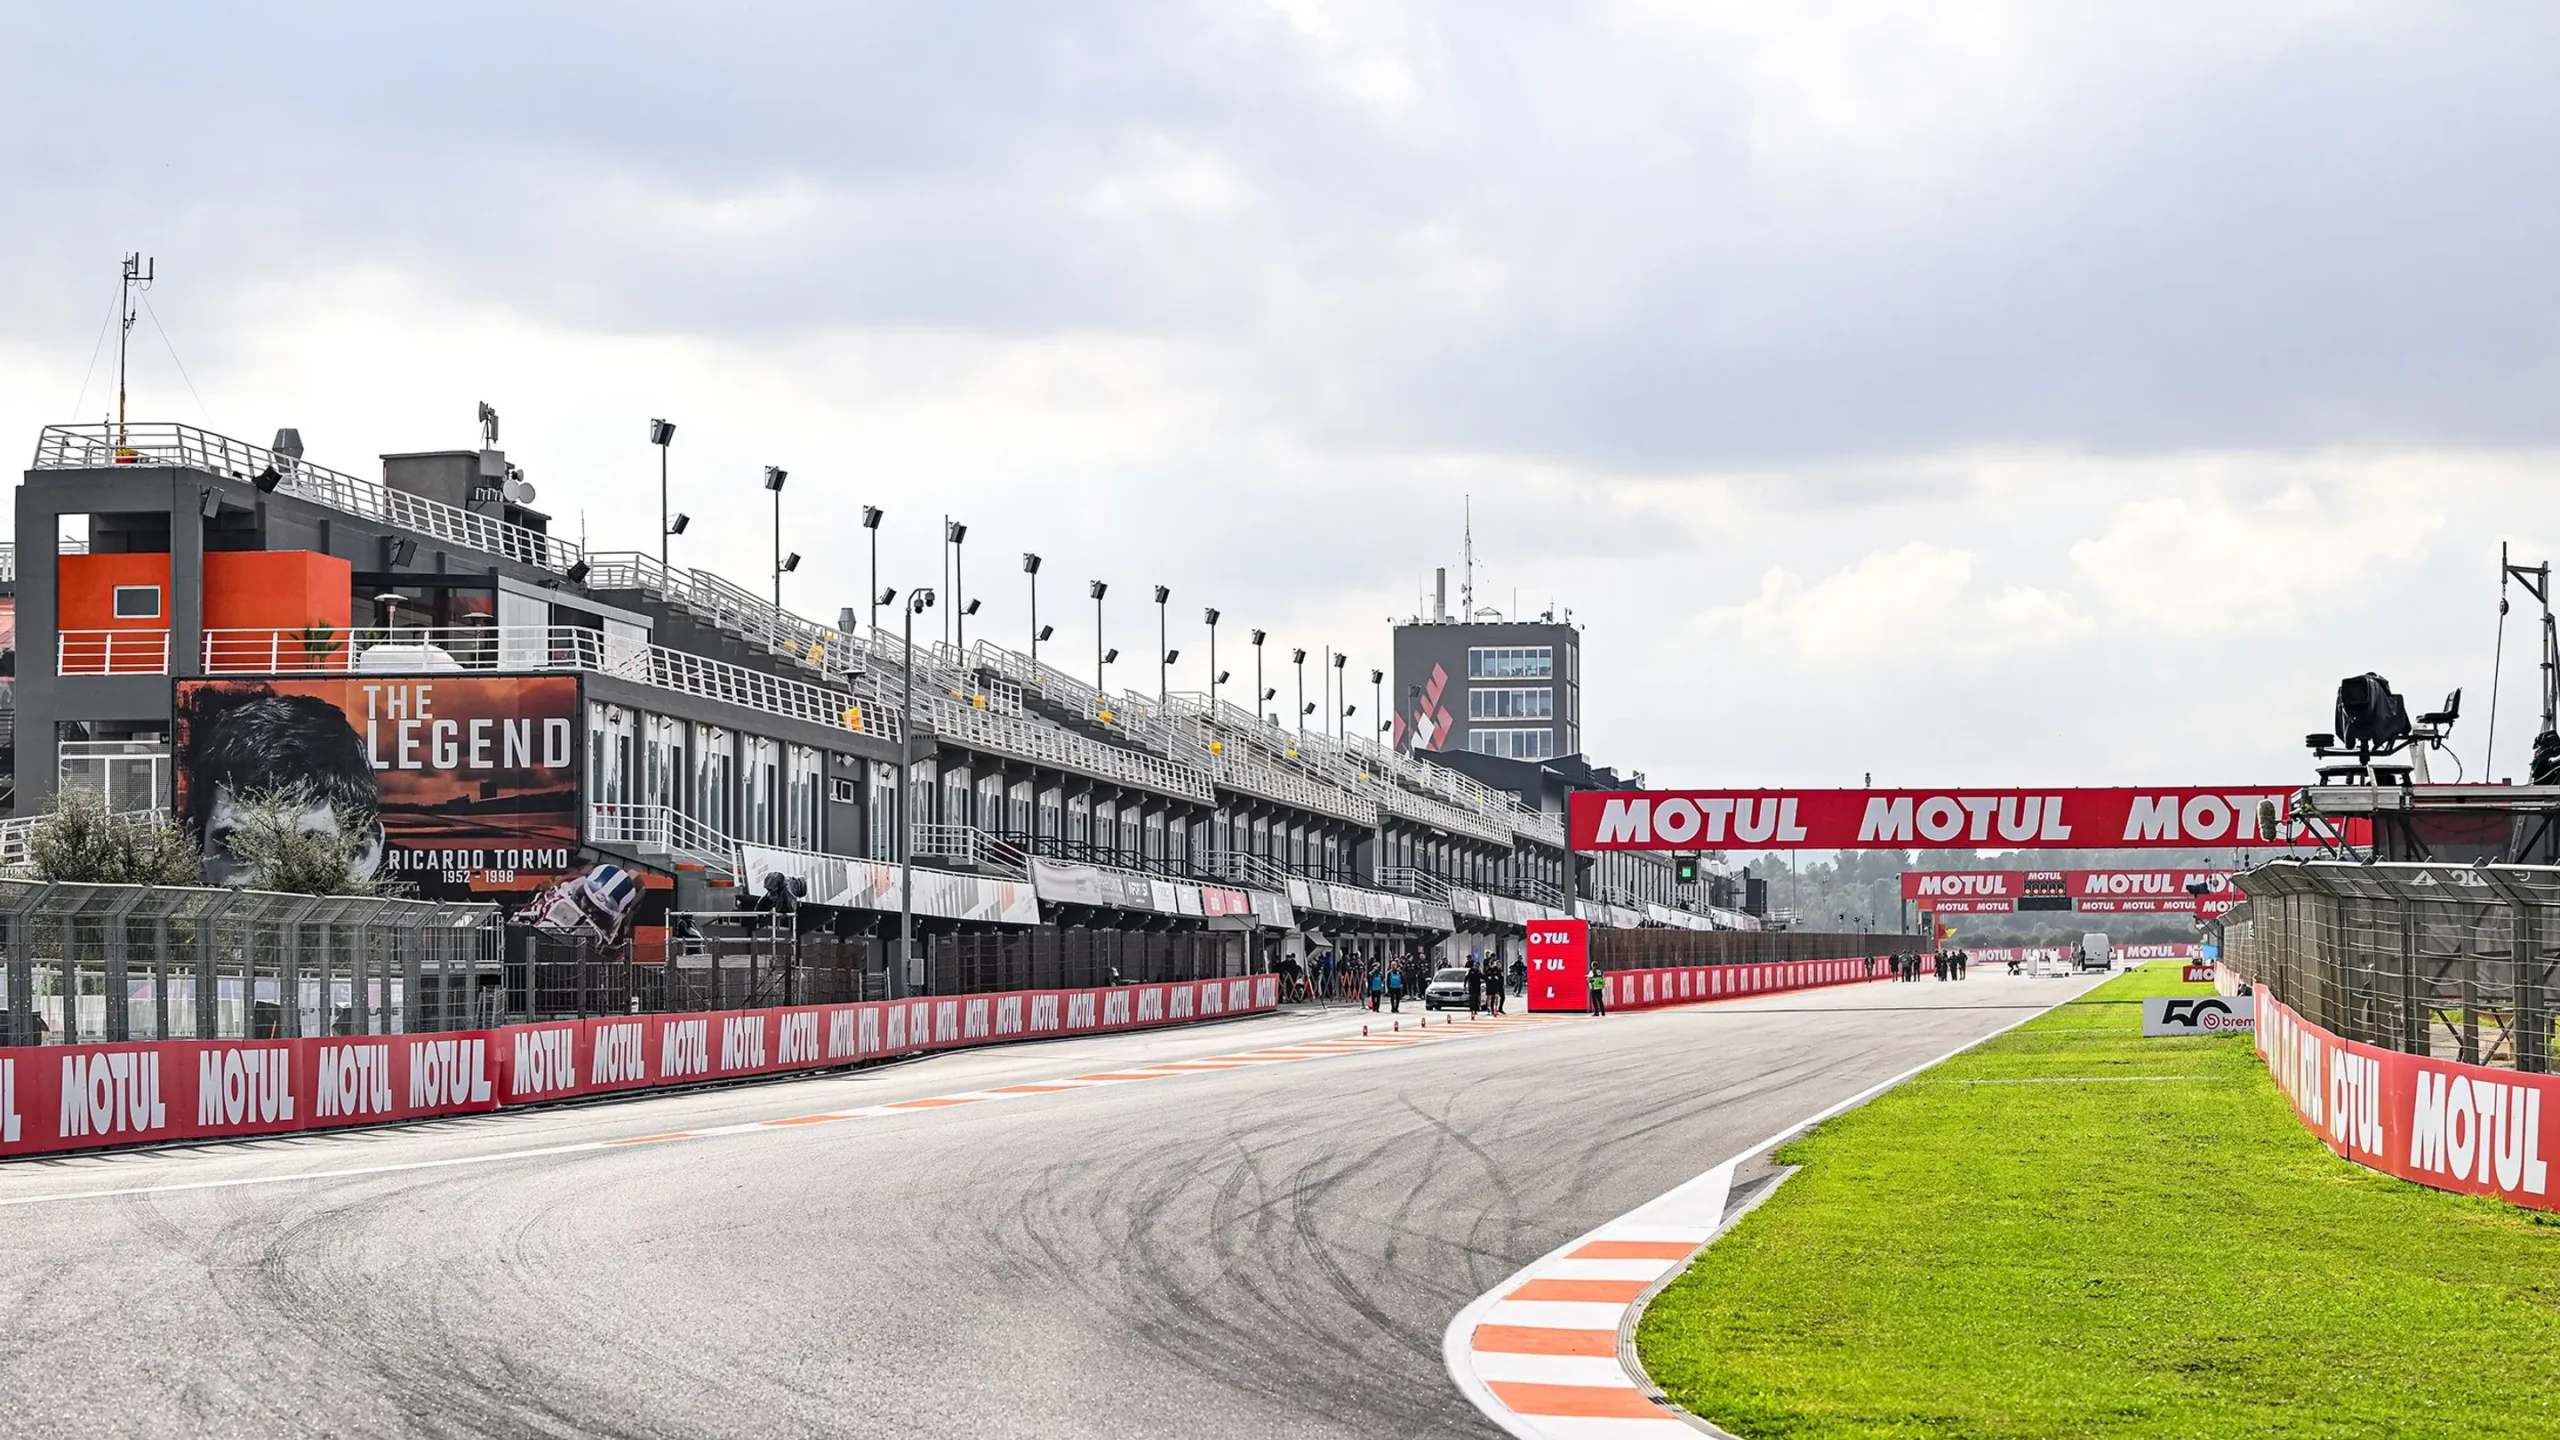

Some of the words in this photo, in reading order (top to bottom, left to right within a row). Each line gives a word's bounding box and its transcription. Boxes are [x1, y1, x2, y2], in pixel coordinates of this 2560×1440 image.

[363, 685, 433, 720] THE
[367, 718, 571, 770] LEGEND
[1595, 797, 1807, 843] MOTUL
[1857, 796, 2072, 841] MOTUL
[388, 850, 484, 870] RICARDO
[494, 849, 568, 869] TORMO
[442, 871, 470, 884] 1952
[485, 871, 514, 883] 1998
[1917, 875, 2006, 895] MOTUL
[2028, 872, 2061, 880] MOTUL
[2085, 874, 2174, 893] MOTUL
[1936, 903, 1969, 911] MOTUL
[1976, 902, 2009, 911] MOTUL
[2082, 902, 2115, 910] MOTUL
[2122, 902, 2155, 910] MOTUL
[2163, 901, 2196, 909] MOTUL
[1978, 949, 2013, 961] MOTUL
[2127, 946, 2175, 957] MOTUL
[1547, 987, 1555, 998] L
[60, 1052, 165, 1137] MOTUL
[198, 1048, 294, 1126] MOTUL
[316, 1044, 392, 1117] MOTUL
[409, 1039, 492, 1108] MOTUL
[512, 1028, 575, 1095] MOTUL
[591, 1023, 645, 1085] MOTUL
[661, 1019, 708, 1077] MOTUL
[721, 1016, 765, 1071] MOTUL
[778, 1011, 818, 1064] MOTUL
[828, 1009, 854, 1058] MOTUL
[964, 998, 988, 1038] MOTUL
[996, 996, 1022, 1034] MOTUL
[1030, 994, 1058, 1031] MOTUL
[1067, 992, 1096, 1028] MOTUL
[1103, 990, 1130, 1025] MOTUL
[1137, 987, 1163, 1022] MOTUL
[1169, 985, 1193, 1018] MOTUL
[1200, 983, 1222, 1015] MOTUL
[1228, 980, 1249, 1011] MOTUL
[1255, 977, 1276, 1007] MOTUL
[2410, 1070, 2548, 1195] MOTUL
